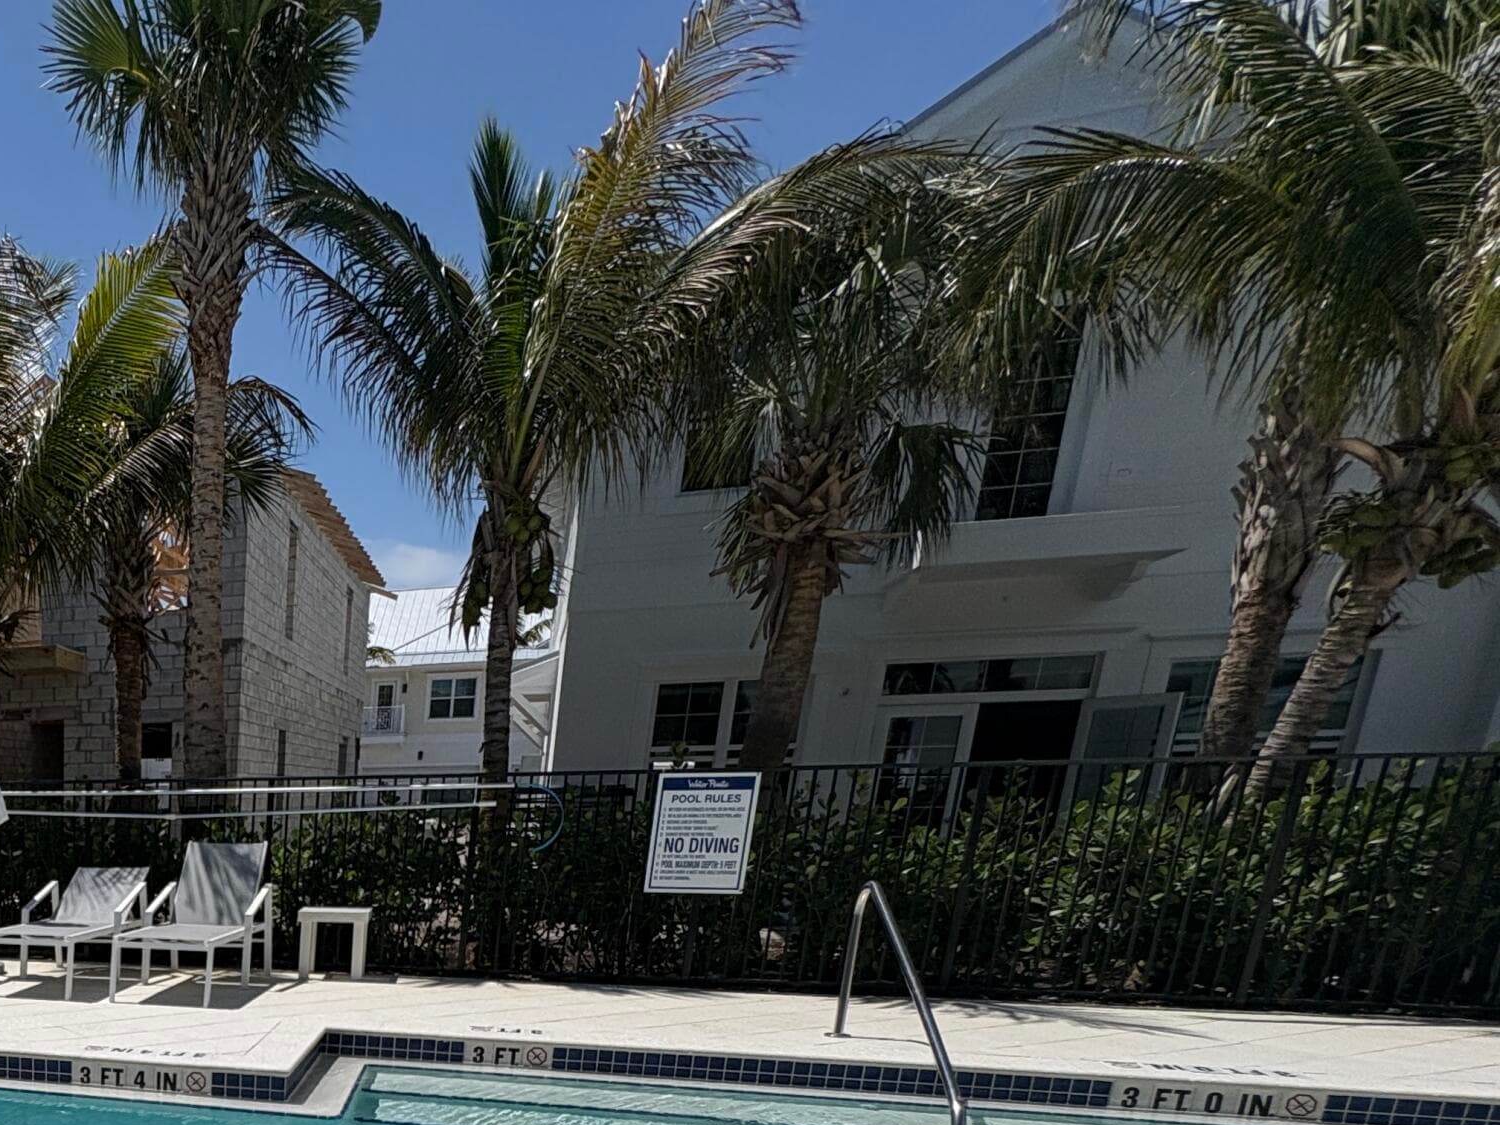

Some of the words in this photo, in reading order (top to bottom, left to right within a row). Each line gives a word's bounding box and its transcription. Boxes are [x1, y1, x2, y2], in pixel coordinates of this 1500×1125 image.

[671, 794, 701, 803] POOL
[704, 794, 742, 803] RULES
[663, 837, 685, 853] NO
[688, 837, 740, 853] DIVING
[472, 1046, 485, 1063] 3
[80, 1066, 91, 1084] 3
[134, 1070, 146, 1088] 4
[1120, 1086, 1140, 1108] 3
[1203, 1092, 1224, 1113] 0
[1237, 1093, 1275, 1117] IN.
